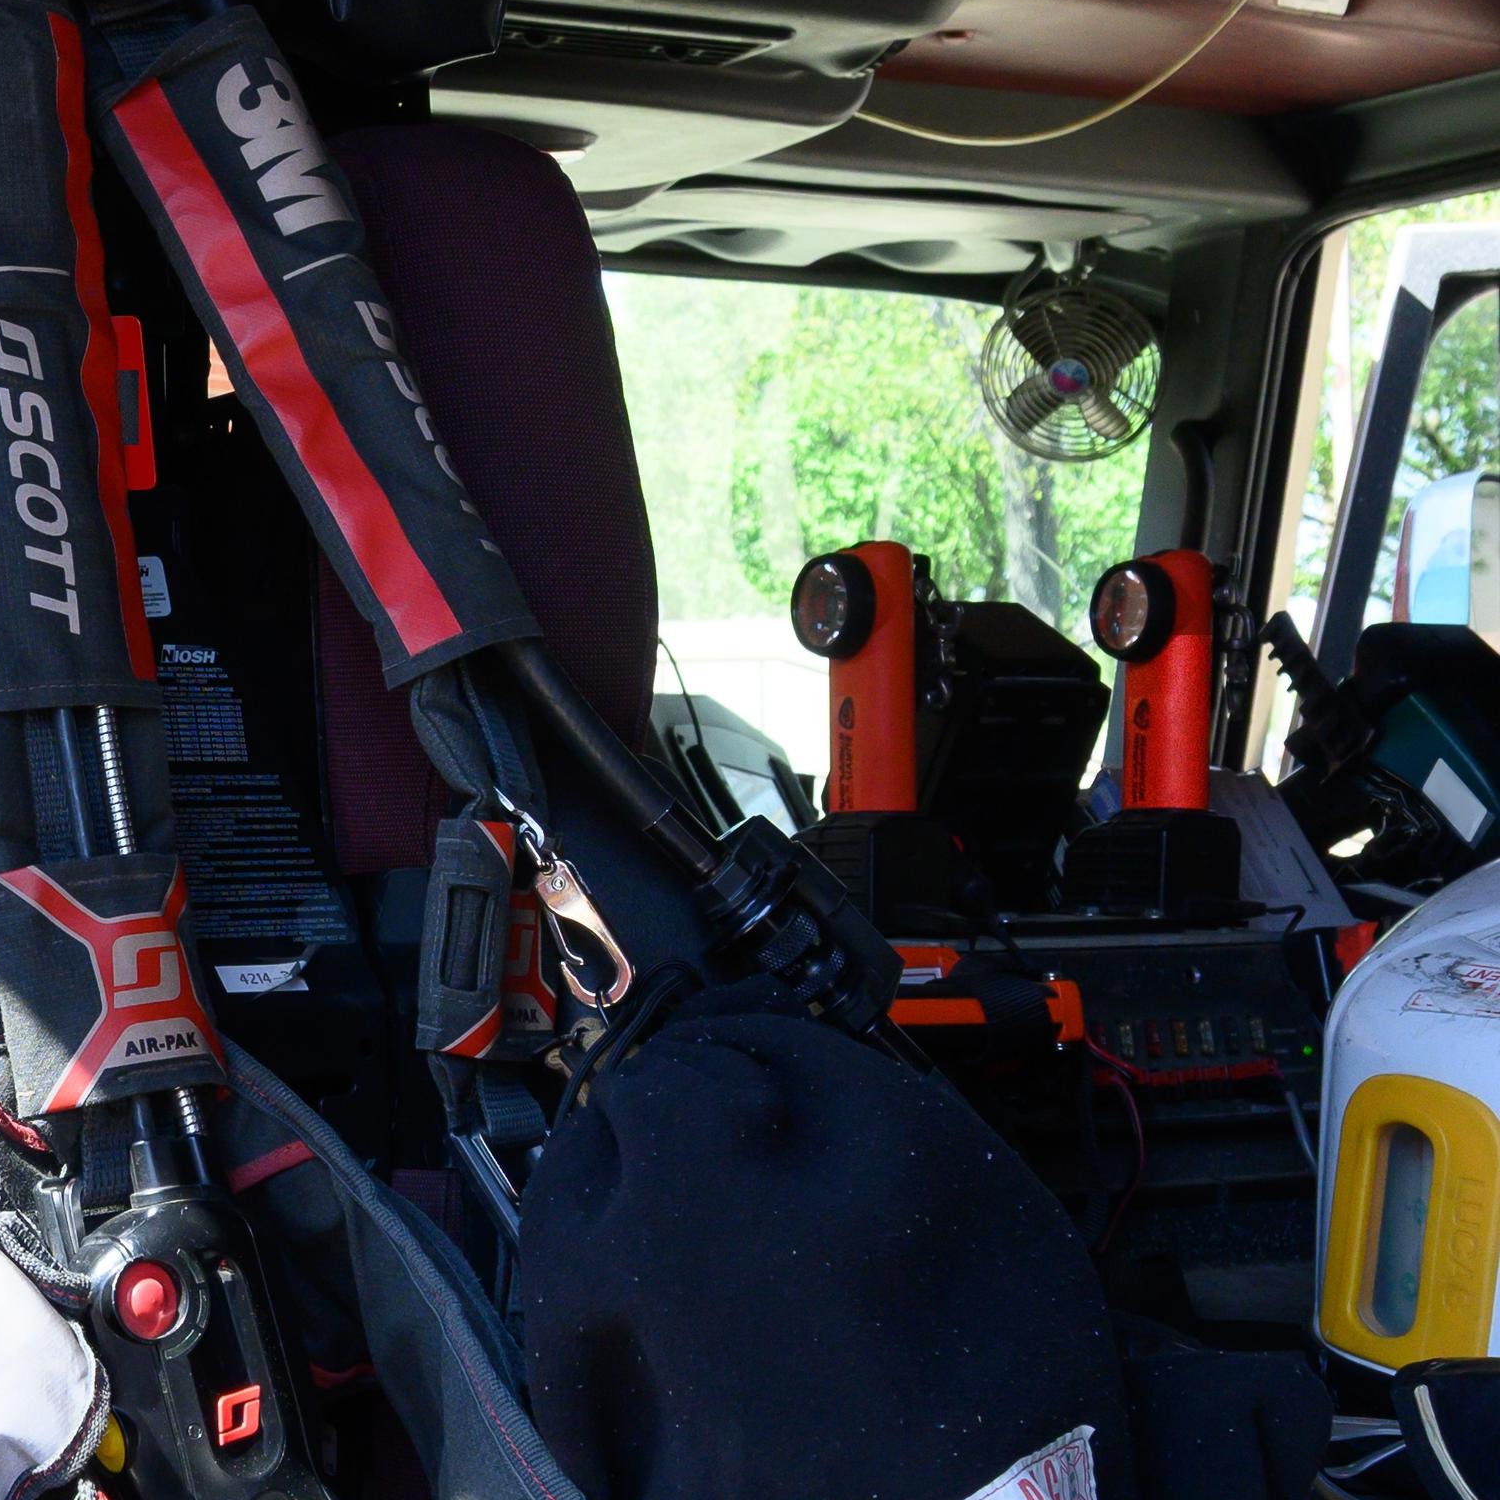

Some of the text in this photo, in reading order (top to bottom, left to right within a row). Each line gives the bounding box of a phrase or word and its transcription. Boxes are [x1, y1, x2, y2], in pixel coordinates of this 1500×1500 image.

[215, 57, 356, 237] 3M
[161, 647, 216, 664] NIOSH
[125, 1031, 198, 1057] AIR-PAK
